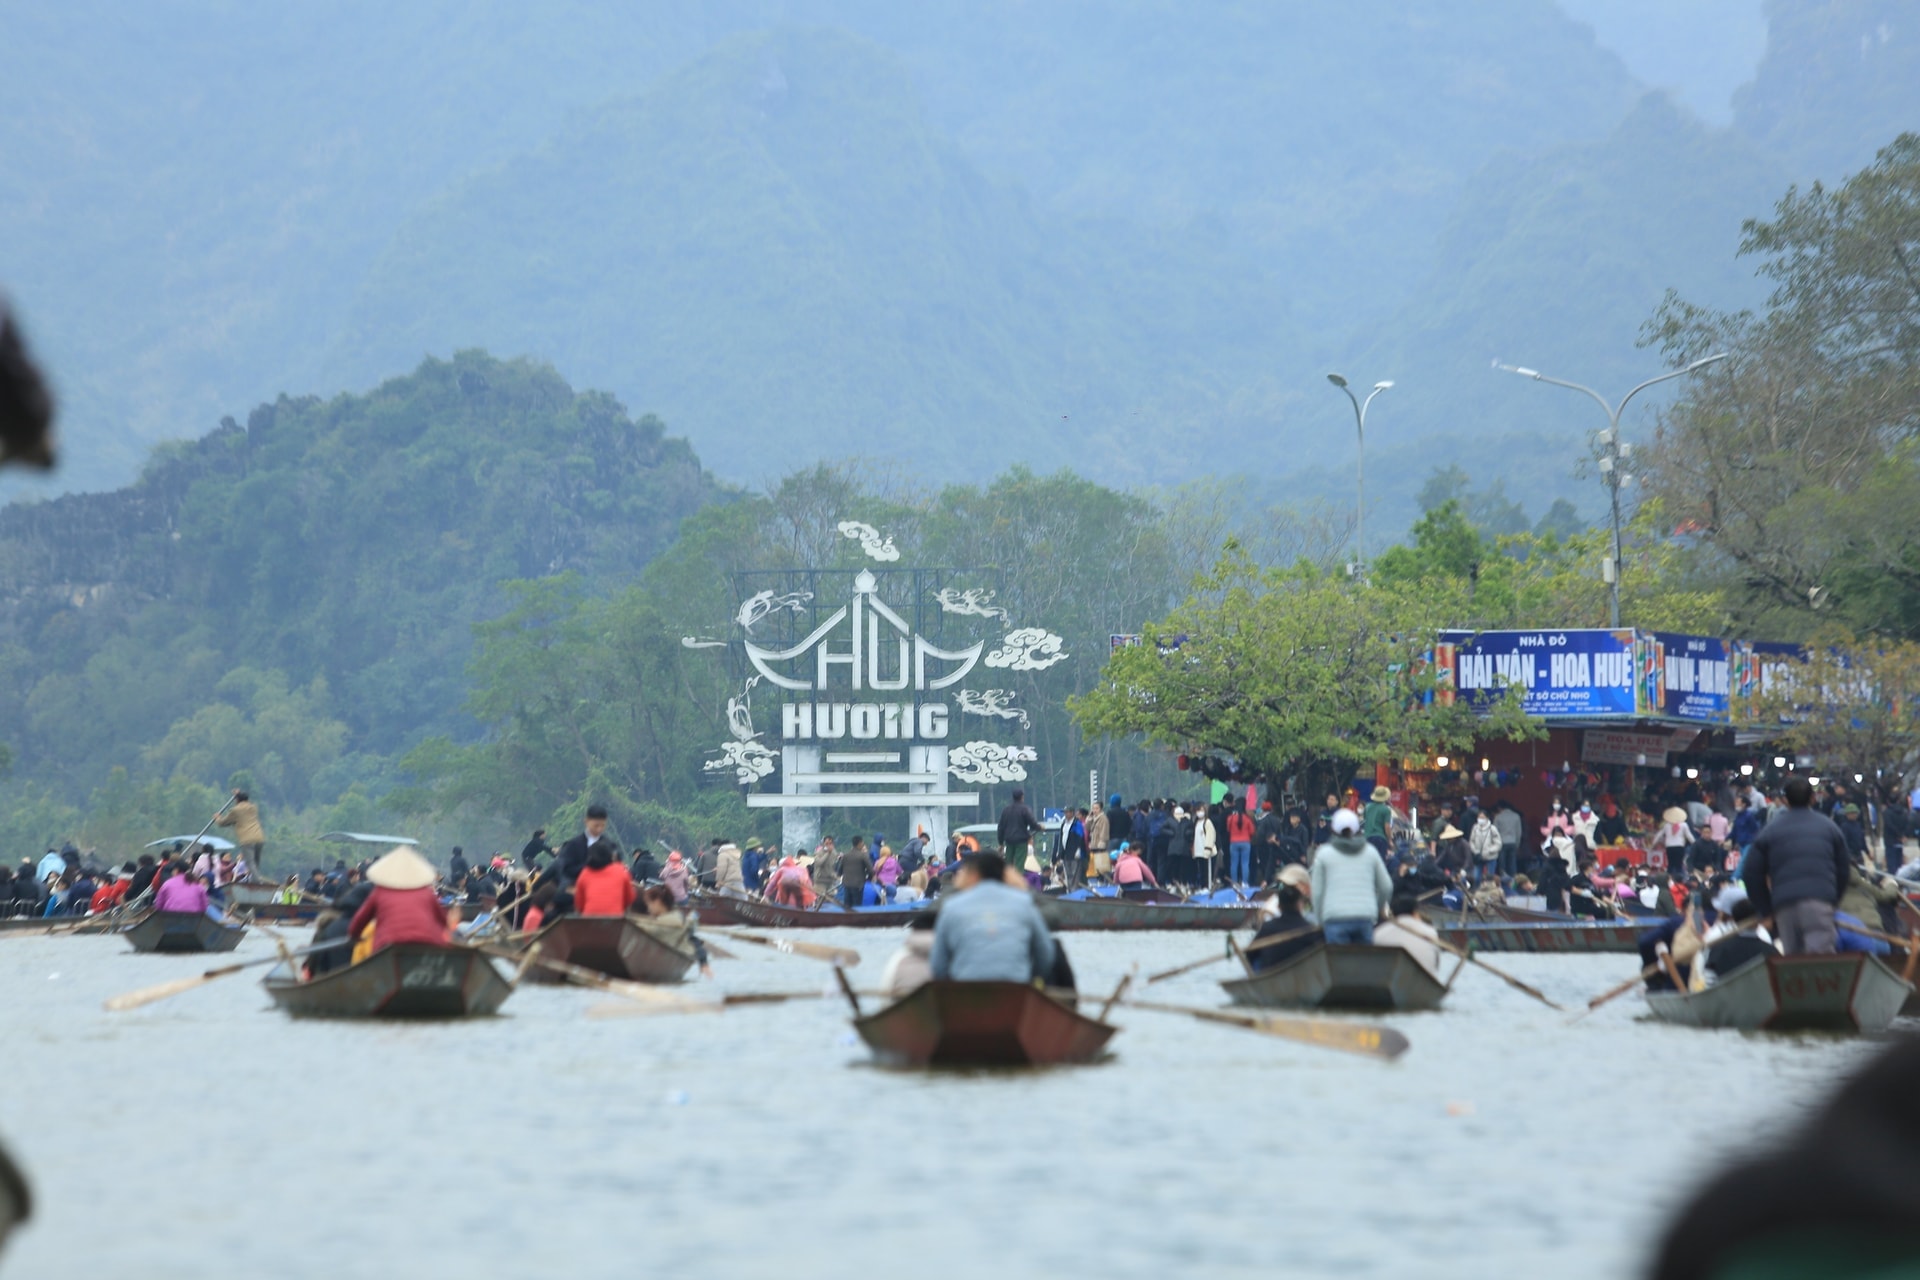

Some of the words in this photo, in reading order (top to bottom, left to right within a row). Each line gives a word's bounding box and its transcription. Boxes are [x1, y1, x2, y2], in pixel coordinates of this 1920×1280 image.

[1519, 634, 1545, 647] NHÀ
[1459, 646, 1492, 689] HẢI
[1495, 648, 1535, 688] VÂN
[1539, 669, 1547, 678] -
[1551, 653, 1591, 688] HOA
[1594, 647, 1632, 693] HUỆ
[1570, 691, 1590, 700] NHO
[1606, 735, 1633, 744] HOA
